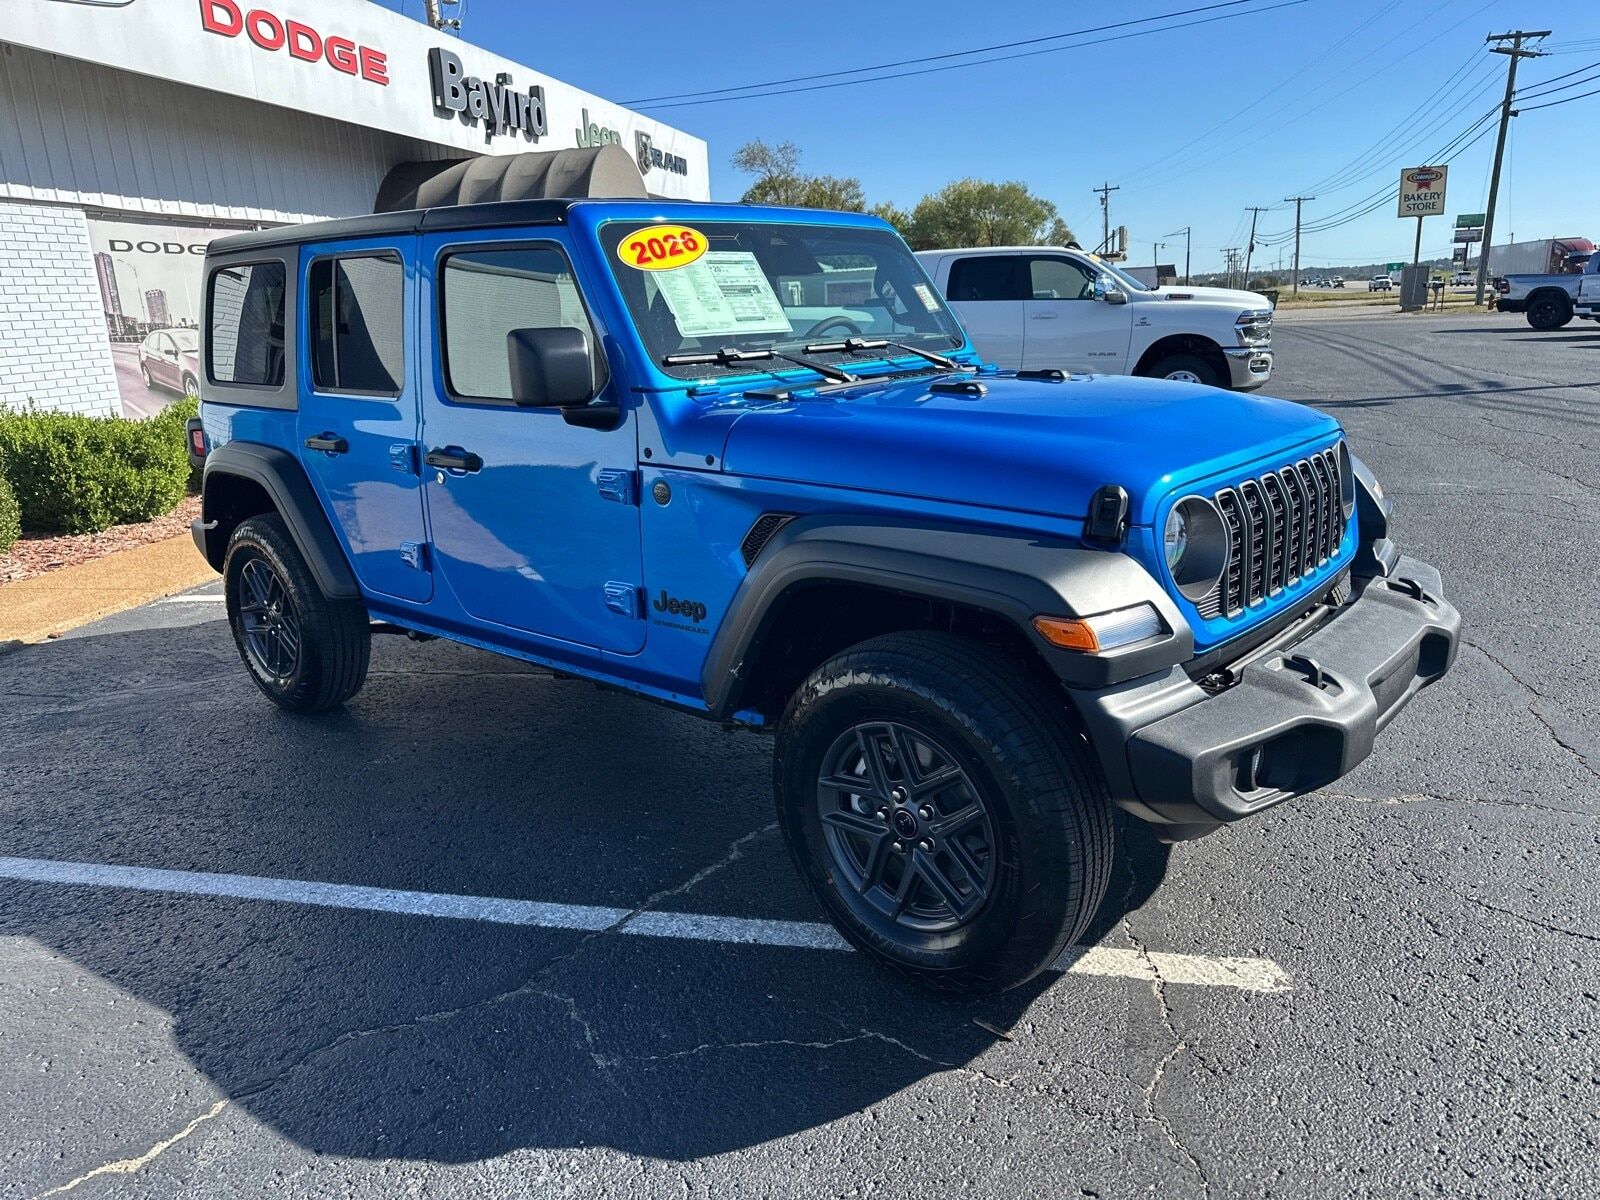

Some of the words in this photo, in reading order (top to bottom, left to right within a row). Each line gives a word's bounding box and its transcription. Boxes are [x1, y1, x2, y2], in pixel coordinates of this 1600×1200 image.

[199, 0, 389, 86] DODGE
[428, 47, 548, 138] Bayird
[651, 148, 688, 176] RAM
[1403, 192, 1442, 202] BAKERY
[1406, 202, 1437, 211] STORE
[630, 231, 698, 265] 2026
[653, 590, 706, 623] Jeep
